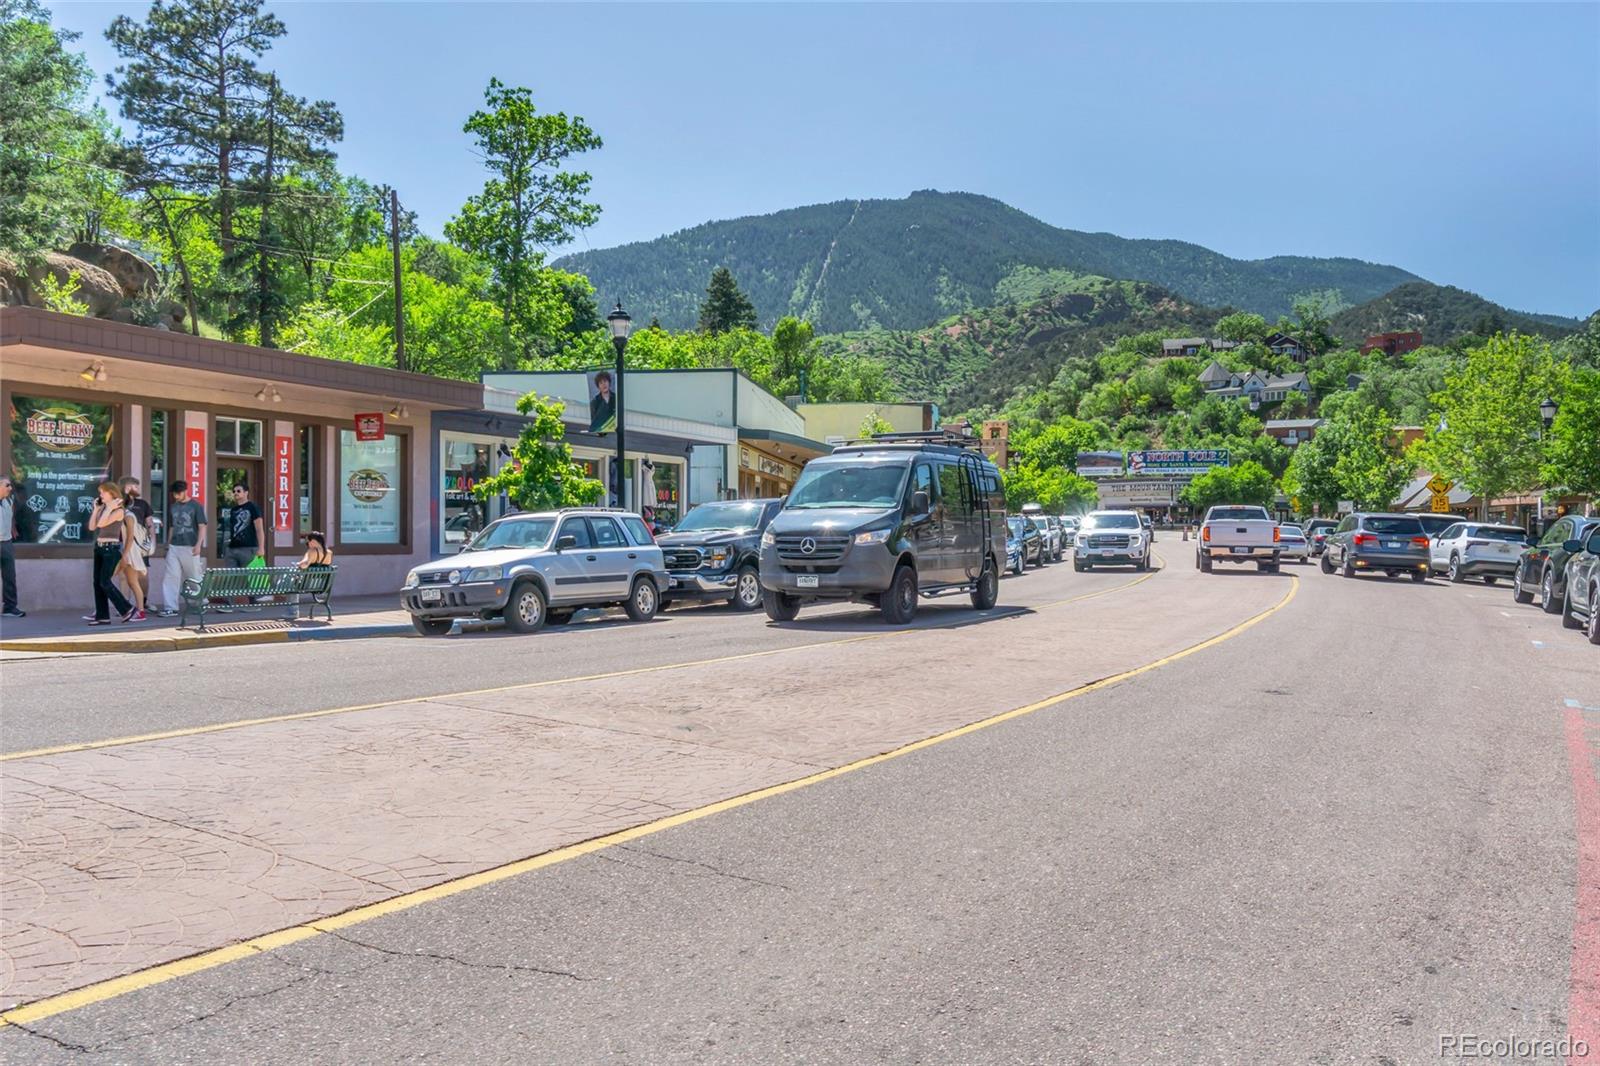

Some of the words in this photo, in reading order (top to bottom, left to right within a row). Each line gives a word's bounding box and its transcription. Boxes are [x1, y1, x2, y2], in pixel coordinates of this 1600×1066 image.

[27, 418, 56, 435] BEEF
[56, 420, 94, 438] JERKY
[1146, 451, 1184, 462] NORTH
[1187, 451, 1217, 461] POLE
[58, 472, 78, 481] perfect
[191, 440, 200, 498] BEE
[279, 440, 289, 528] JERKY
[1435, 498, 1446, 506] 15
